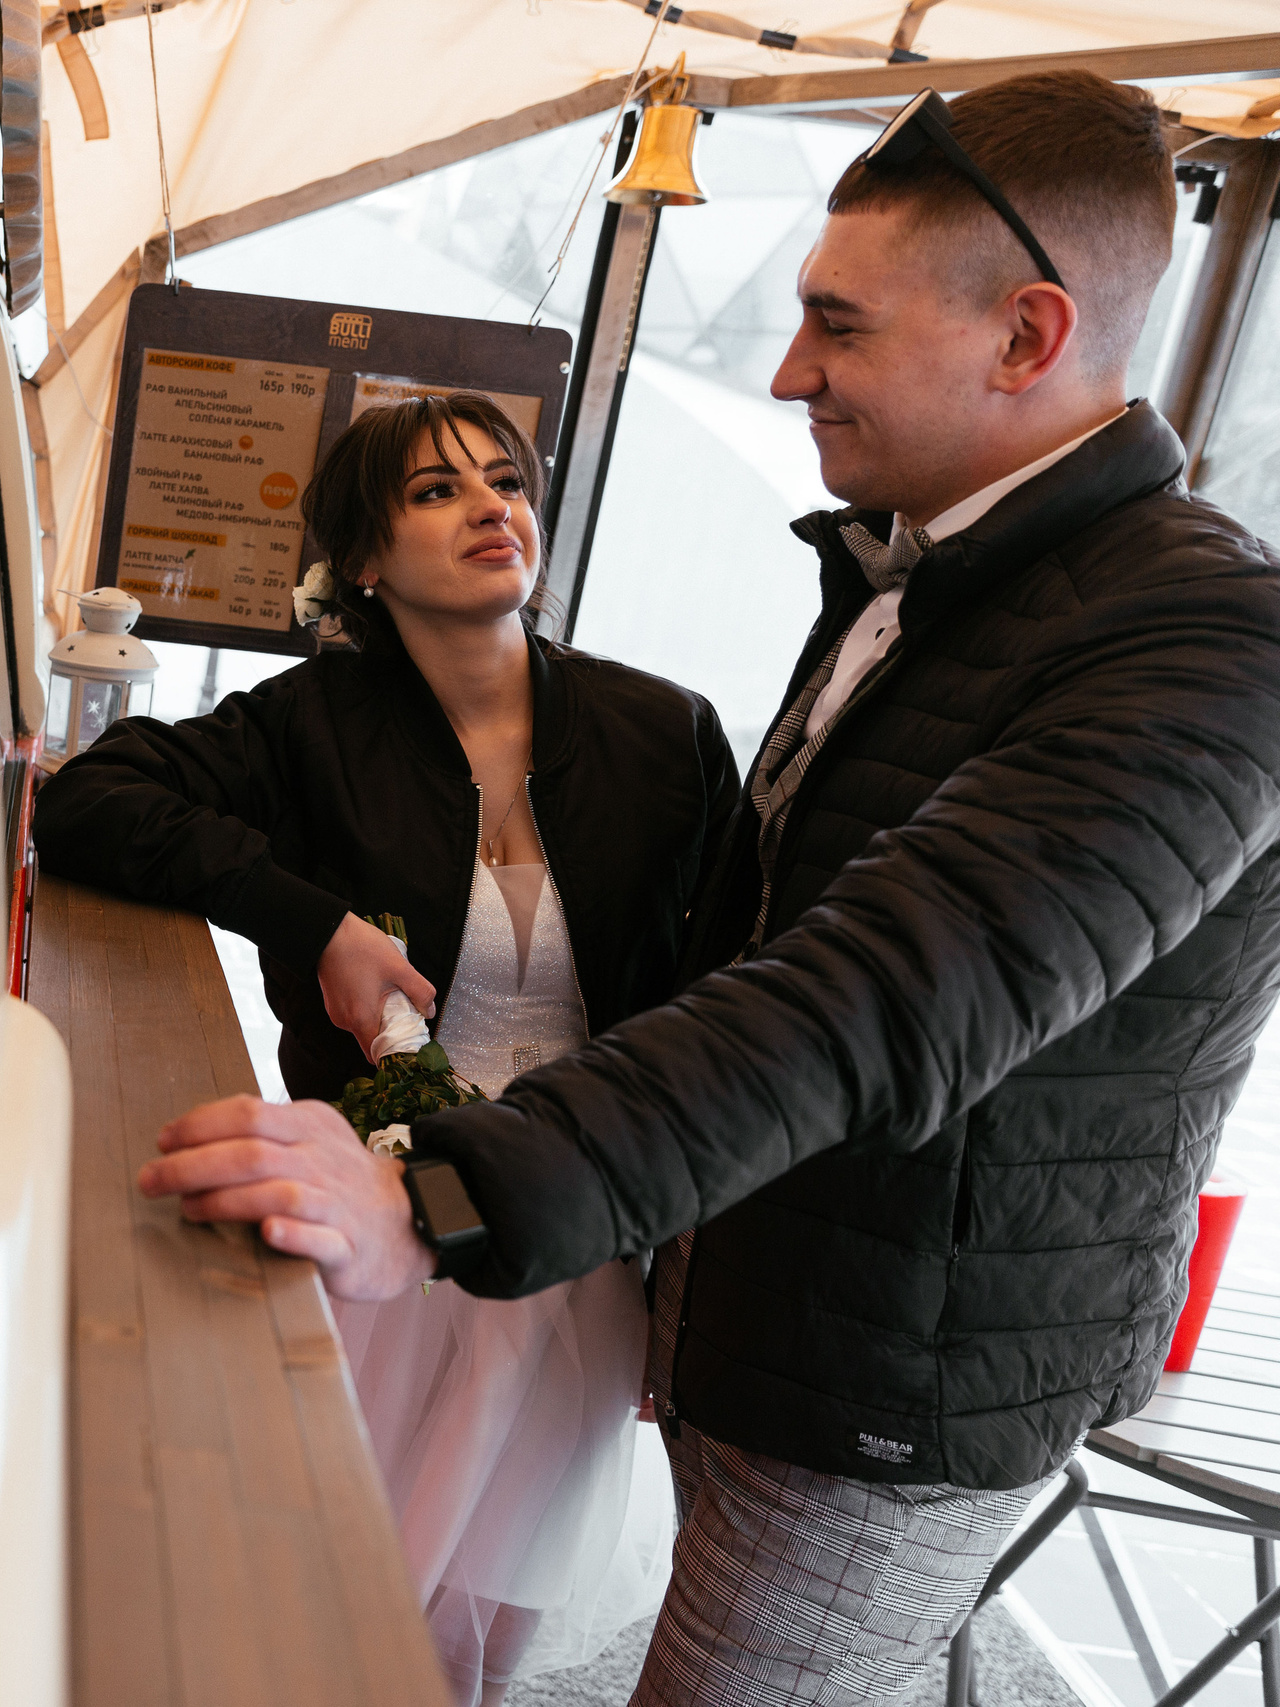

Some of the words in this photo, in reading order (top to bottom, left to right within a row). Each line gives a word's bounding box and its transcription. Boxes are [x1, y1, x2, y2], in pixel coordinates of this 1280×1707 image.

[329, 322, 372, 339] BULLI
[328, 335, 369, 350] menu
[148, 353, 205, 369] АВТОРСКИЙ
[205, 359, 233, 372] КОФЕ
[145, 383, 166, 394] РАФ
[167, 385, 228, 400] ВАНИЛЬНЫЙ
[174, 399, 253, 415] АПЕЛЬСИНОВЫЙ
[234, 418, 285, 432] КАРАМЕЛЬ
[139, 431, 168, 442] ЛАТТЕ
[169, 434, 233, 449] АРАХИСОВЫЙ
[183, 449, 242, 464] БАНАНОВЫЙ
[244, 456, 264, 465] РАФ
[135, 467, 181, 480] ХВОЙНЫЙ
[182, 472, 203, 481] РАФ
[148, 481, 177, 491] ЛАТТЕ
[178, 484, 209, 495] ХАЛВА
[162, 495, 223, 509] МАЛИНОВЫЙ
[224, 501, 245, 511] РАФ
[176, 509, 271, 527] МЕДОВО-ИМБИРНЫЙ
[273, 519, 302, 531] ЛАТТЕ
[127, 525, 169, 540] ГОРЯЧИЙ
[171, 531, 218, 545] ШОКОЛАД
[124, 550, 152, 561] ЛАТТЕ
[154, 554, 184, 564] МАТЧА
[858, 1432, 913, 1452] PULL&BEAR
